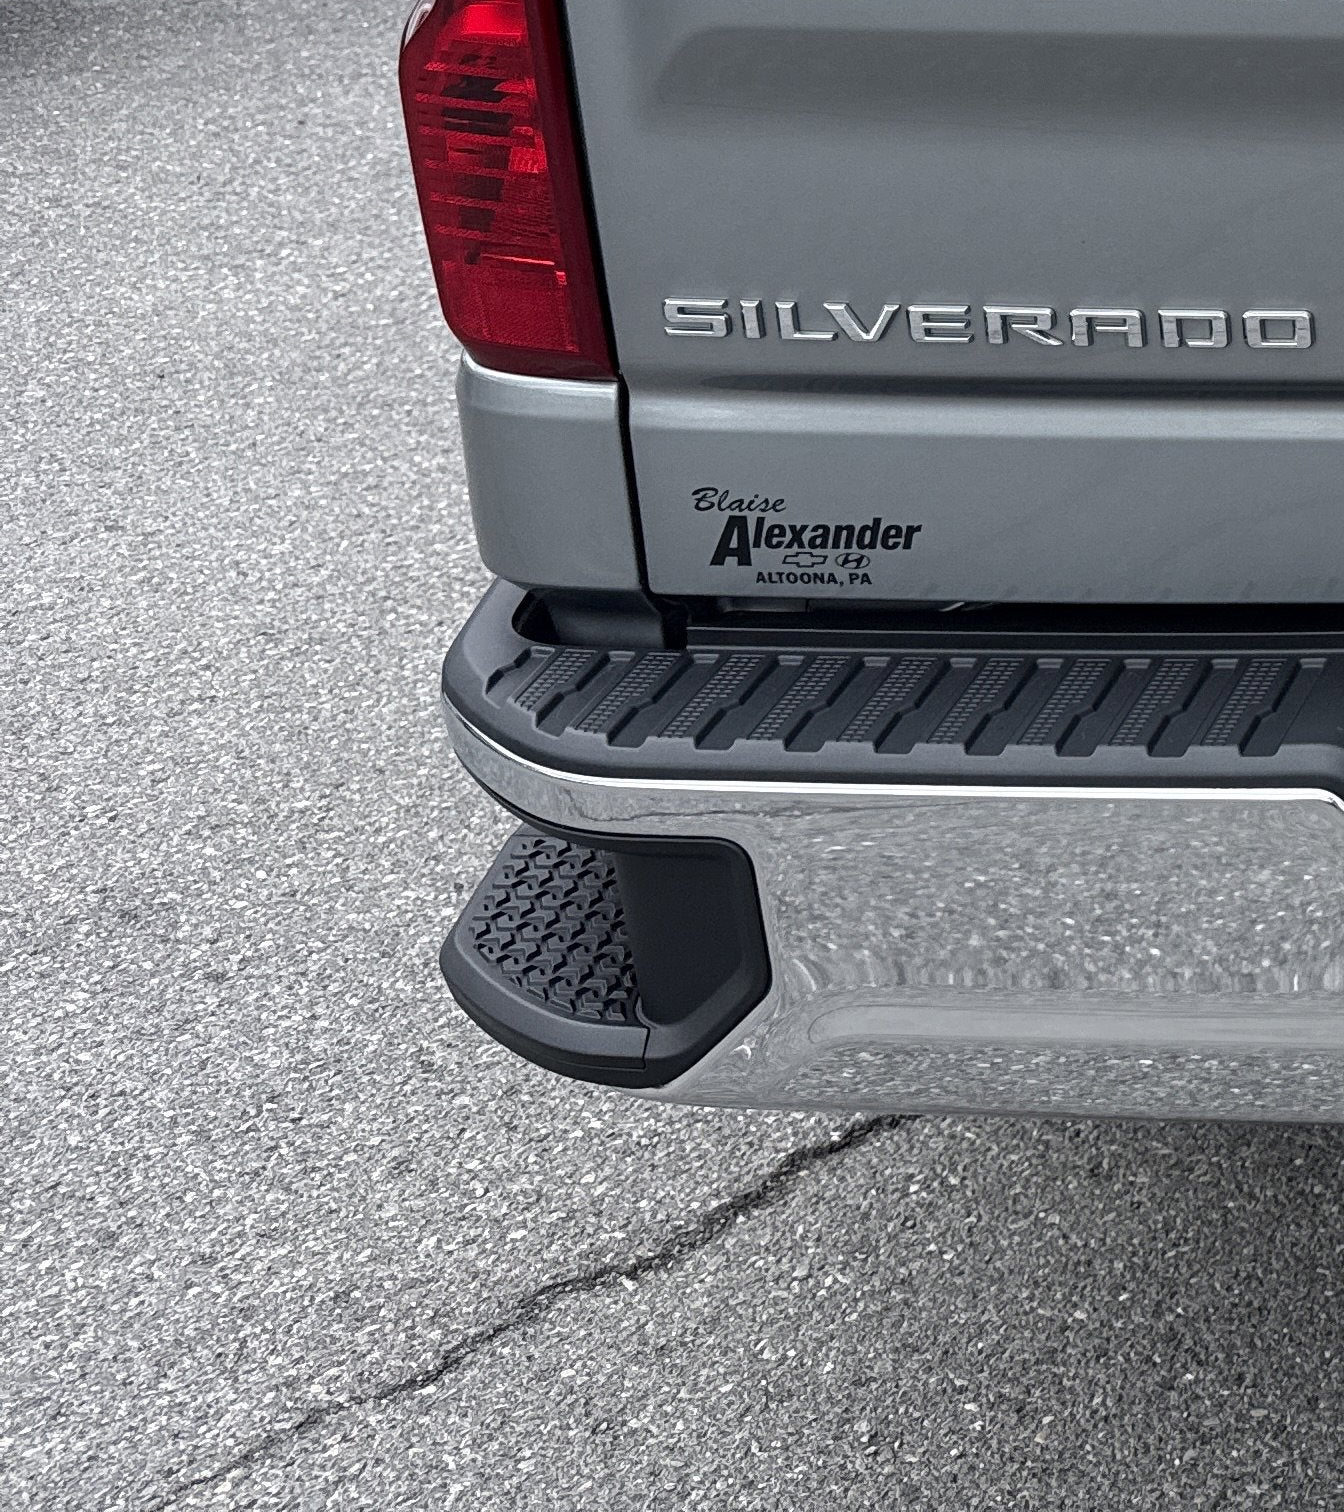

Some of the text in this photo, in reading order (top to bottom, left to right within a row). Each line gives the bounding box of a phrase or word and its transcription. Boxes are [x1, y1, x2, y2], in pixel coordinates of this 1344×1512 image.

[662, 296, 1317, 349] SILVERADO
[691, 486, 787, 513] Blaise
[709, 514, 923, 566] Alexander
[755, 570, 873, 587] ALTOONA, PA
